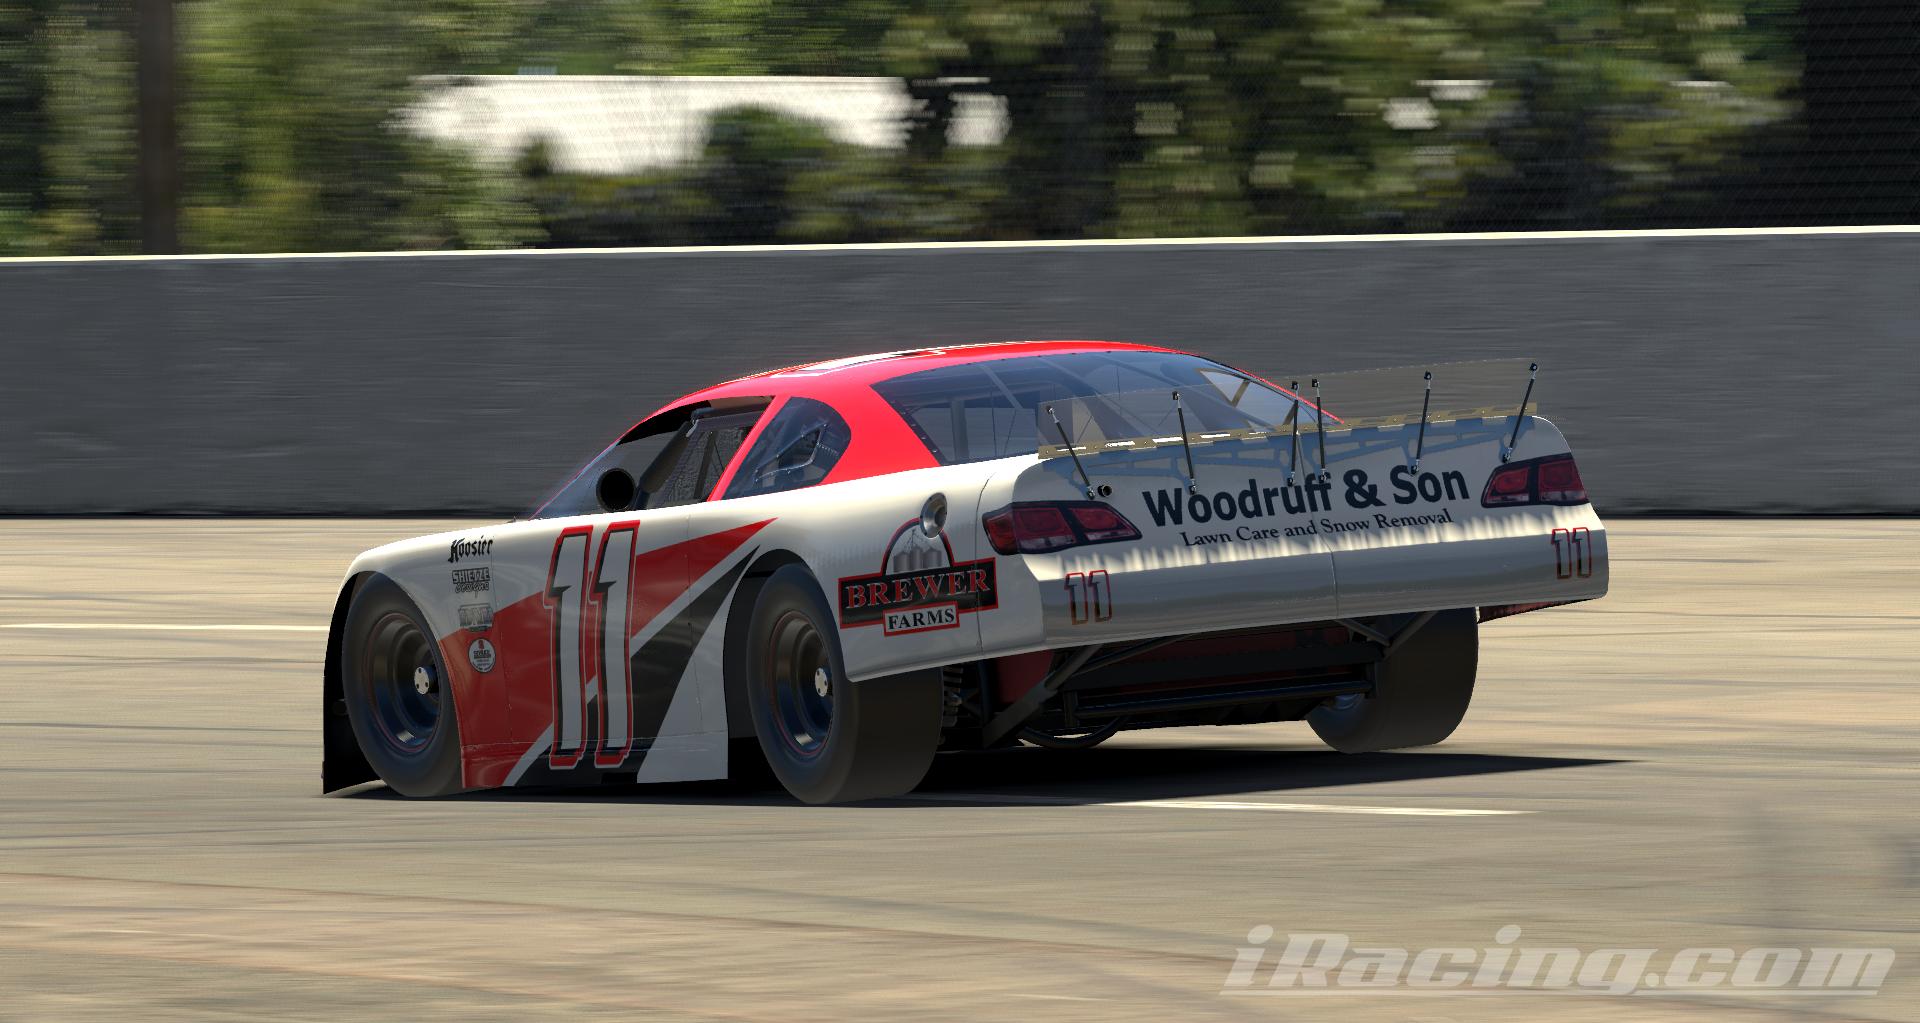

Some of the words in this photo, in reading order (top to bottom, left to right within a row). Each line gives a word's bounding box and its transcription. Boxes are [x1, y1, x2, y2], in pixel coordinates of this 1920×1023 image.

[1143, 472, 1332, 527] Woodruff
[1343, 469, 1387, 509] &
[1390, 464, 1470, 505] Son
[448, 535, 494, 563] Hoosier
[1180, 531, 1233, 547] Lawn
[1236, 526, 1280, 541] Care
[1285, 520, 1318, 537] and
[1320, 518, 1371, 534] Snow
[1374, 508, 1454, 529] Removal
[1551, 527, 1592, 579] 11
[845, 569, 991, 609] BREWER
[1063, 569, 1112, 626] 11
[888, 608, 955, 630] FARMS
[543, 519, 641, 770] 11
